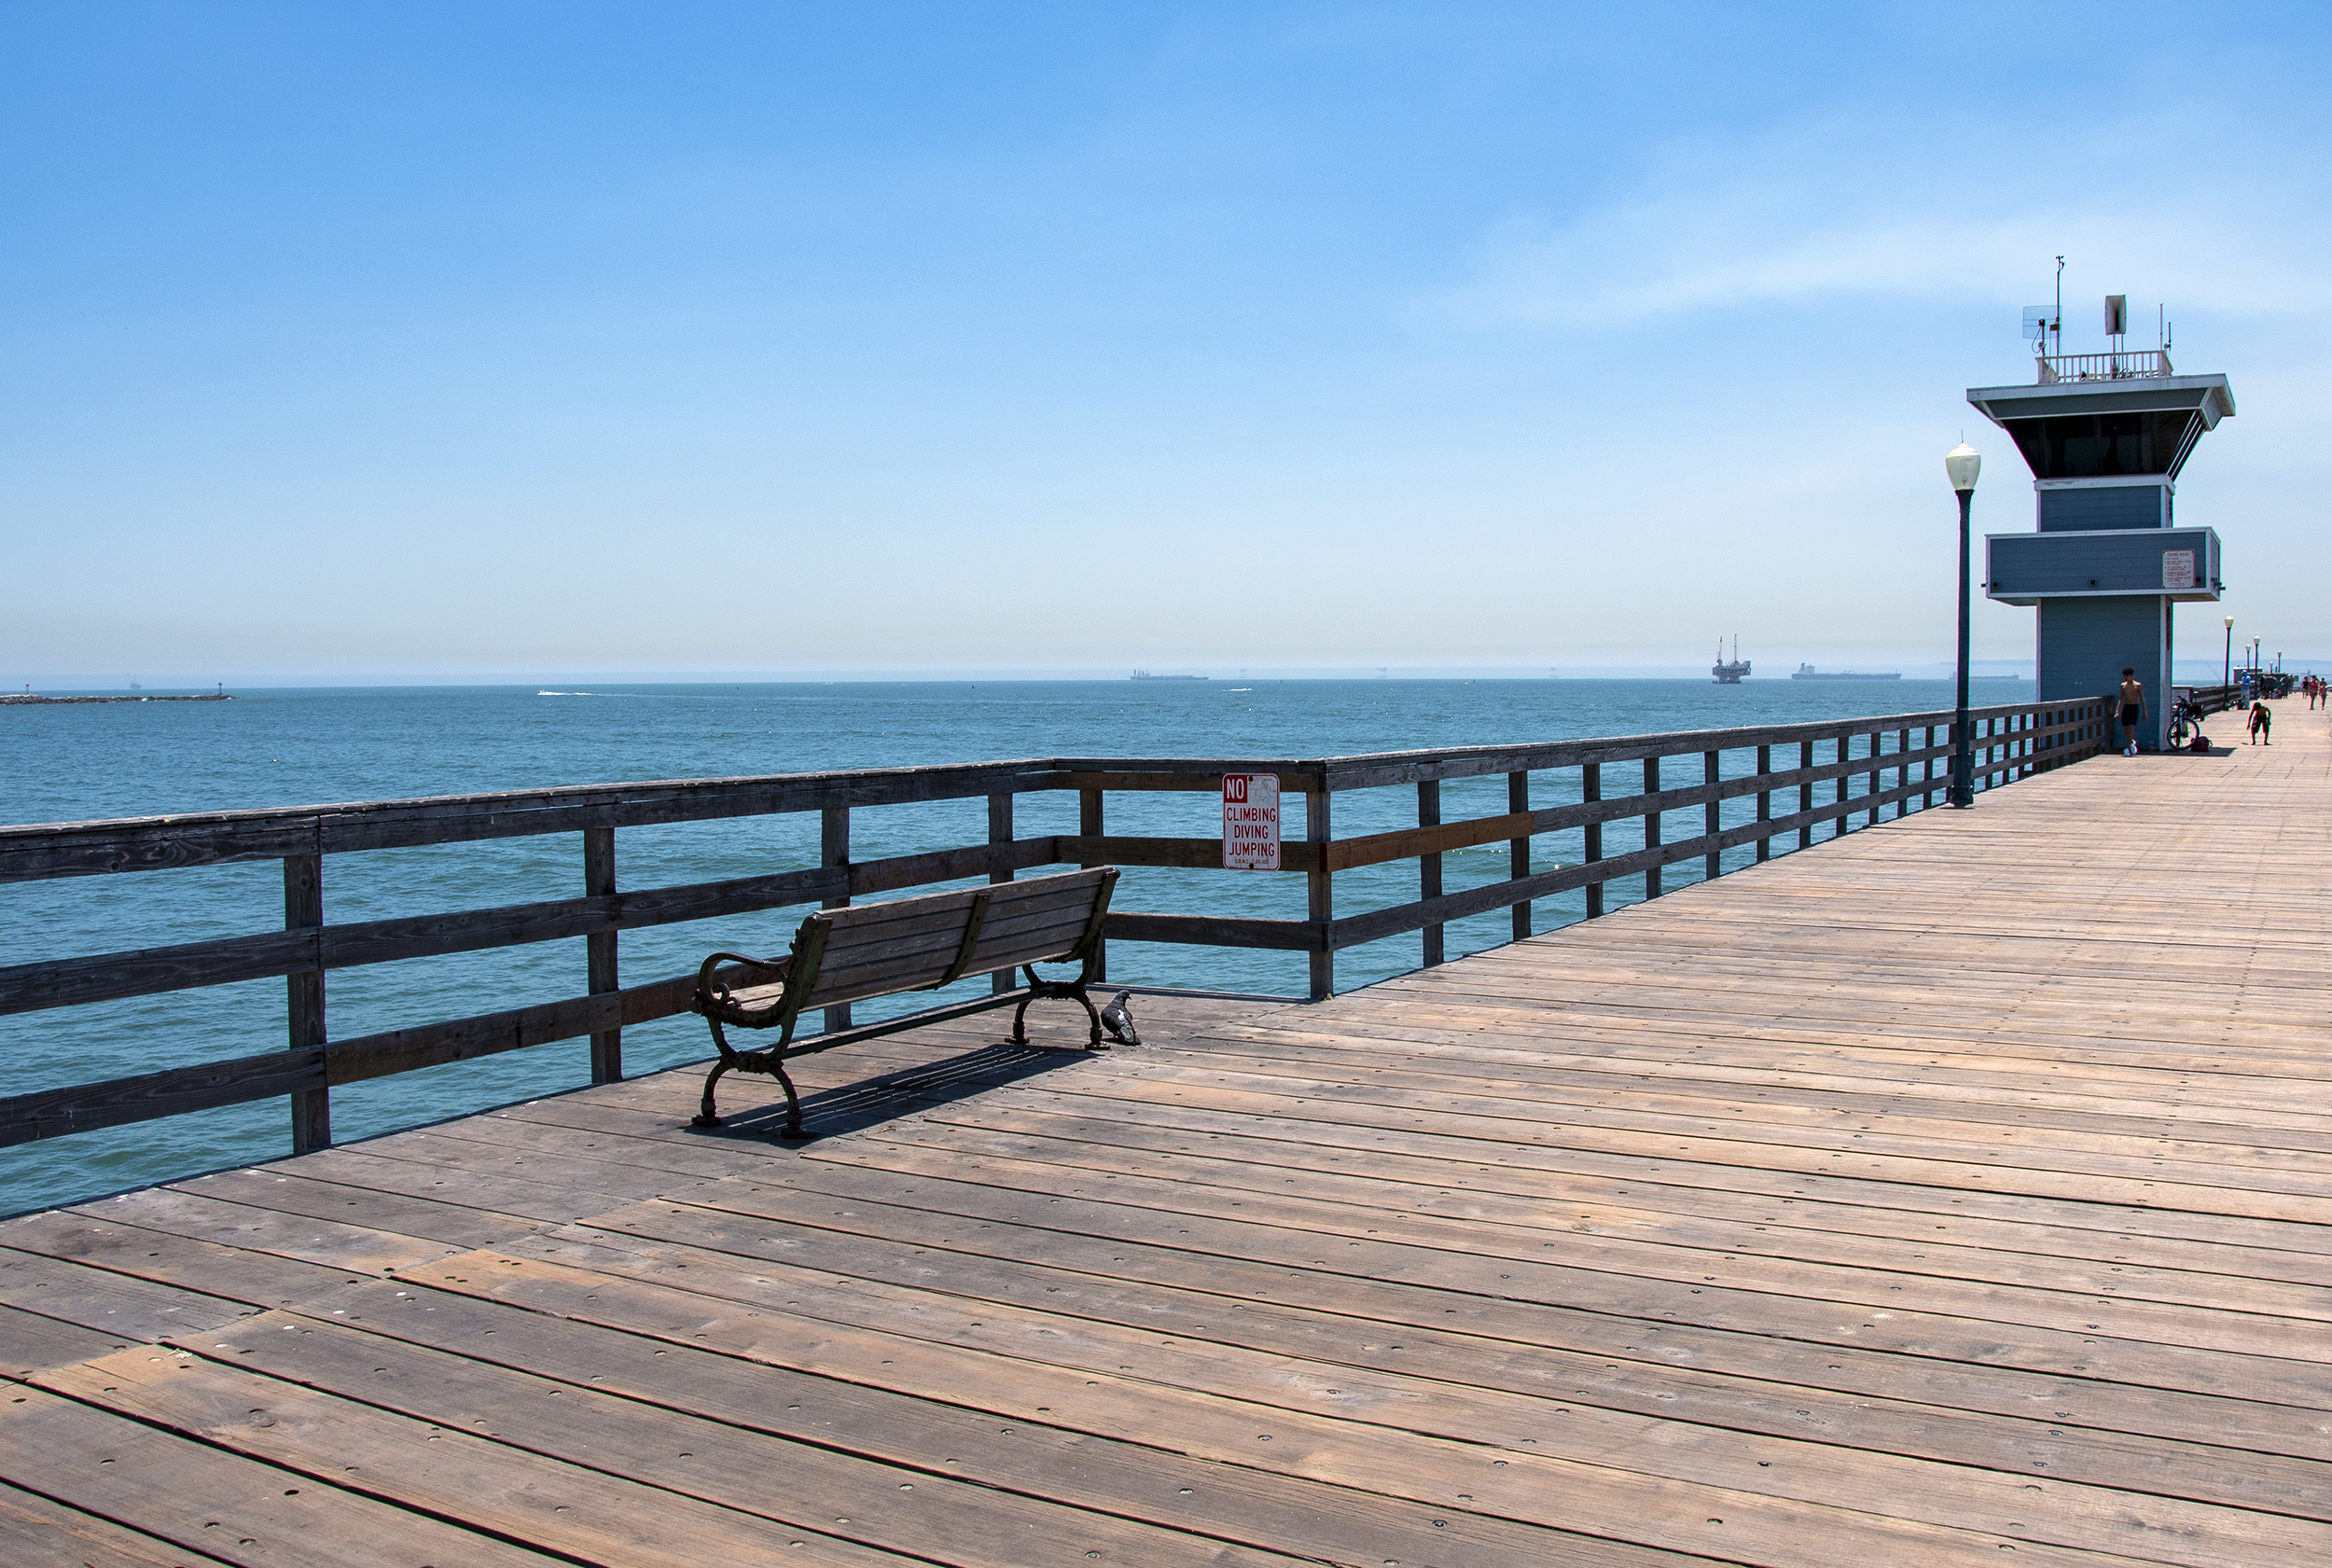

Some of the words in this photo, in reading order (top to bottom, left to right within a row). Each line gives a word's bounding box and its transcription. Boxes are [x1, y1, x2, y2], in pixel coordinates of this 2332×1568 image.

[1227, 779, 1244, 799] NO
[1227, 807, 1276, 822] CLIMBING
[1234, 825, 1269, 840] DIVING
[1228, 841, 1275, 857] JUMPING
